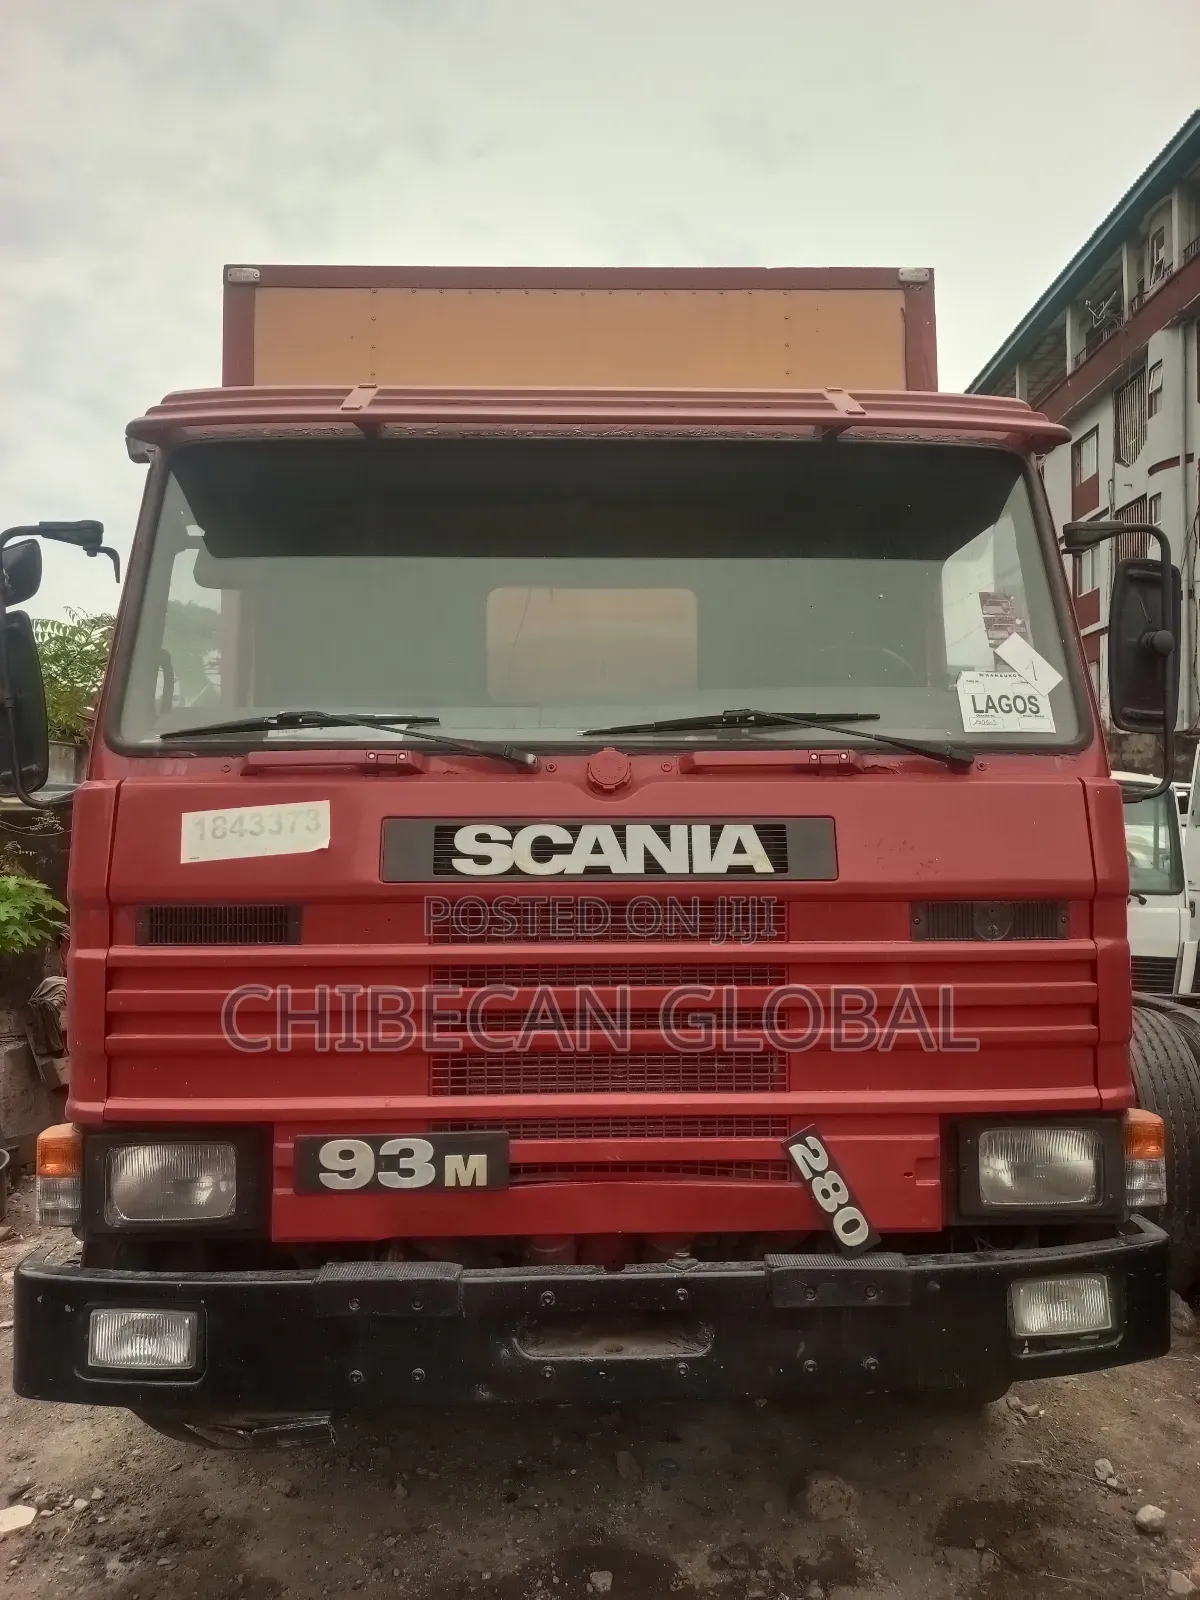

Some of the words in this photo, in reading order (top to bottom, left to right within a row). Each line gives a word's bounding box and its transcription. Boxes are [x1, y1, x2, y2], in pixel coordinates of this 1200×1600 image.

[971, 694, 1040, 714] LAGOS
[195, 808, 321, 841] 1843373
[451, 824, 775, 876] SCANIA
[788, 1136, 869, 1247] 280
